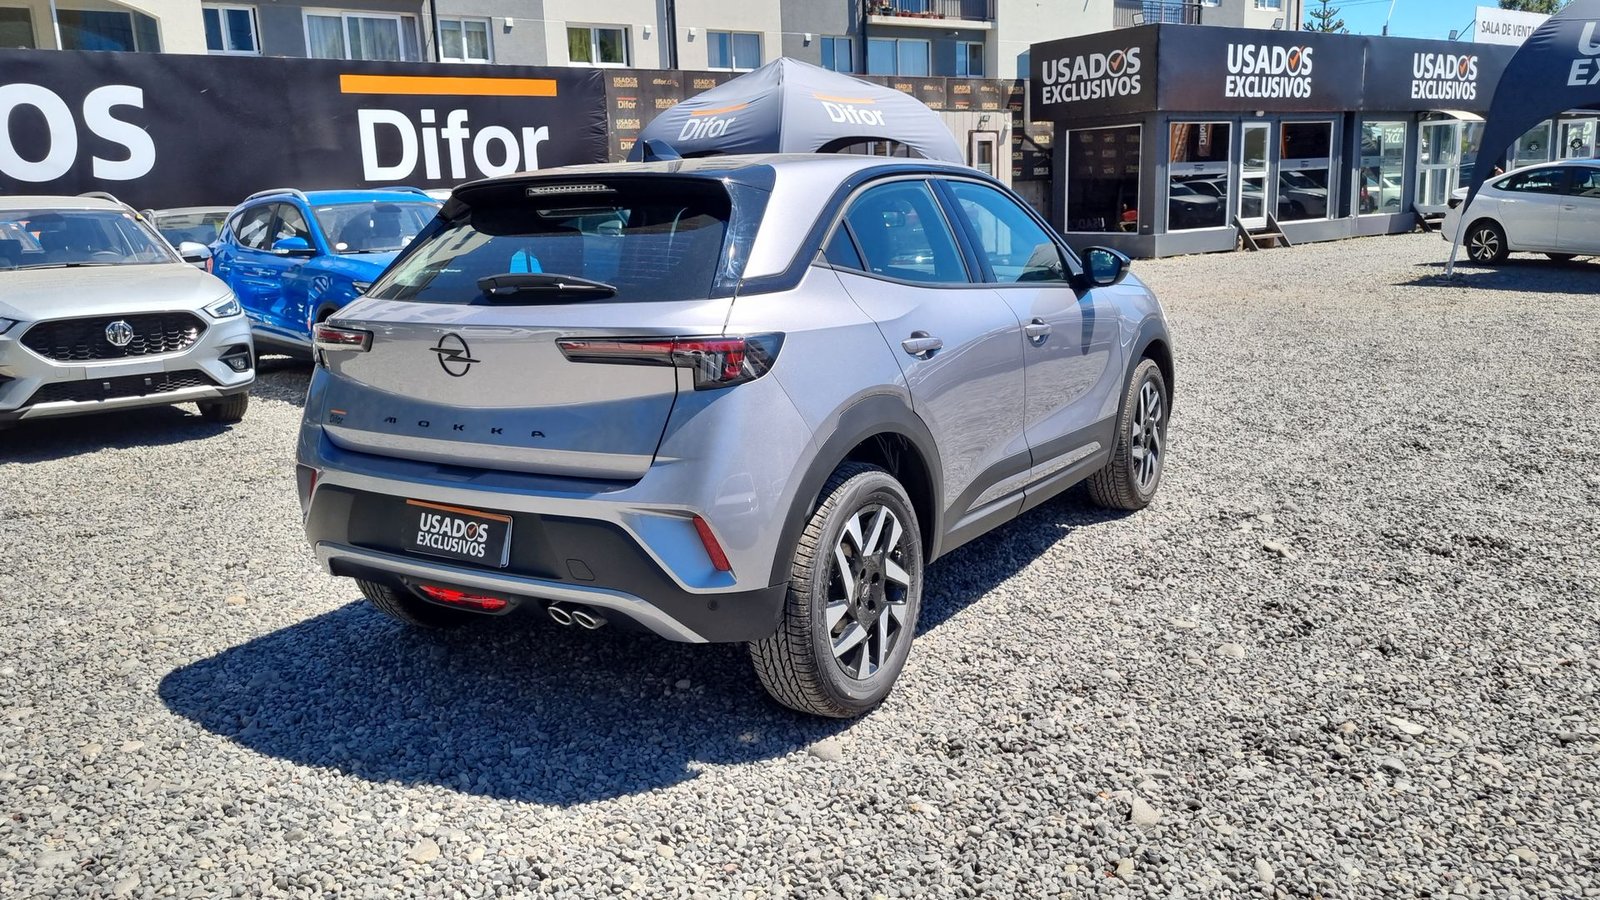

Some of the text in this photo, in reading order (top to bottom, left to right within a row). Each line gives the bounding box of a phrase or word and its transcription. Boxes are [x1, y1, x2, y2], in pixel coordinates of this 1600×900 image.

[1481, 21, 1500, 35] SALA
[1502, 23, 1512, 36] DE
[1042, 47, 1141, 85] USADOS
[1227, 43, 1313, 77] USADOS
[1412, 53, 1478, 81] USADOS
[1042, 74, 1141, 105] EXCLUSIVOS
[1225, 75, 1312, 98] EXCLUSIVOS
[1410, 80, 1477, 100] EXCLUSIVOS
[821, 100, 885, 127] Difor
[0, 83, 156, 182] OS
[678, 115, 736, 141] Difor
[357, 108, 550, 181] Difor
[384, 415, 547, 439] MOKKA
[419, 512, 489, 543] USADOS
[416, 531, 486, 558] EXCLUSIVOS
